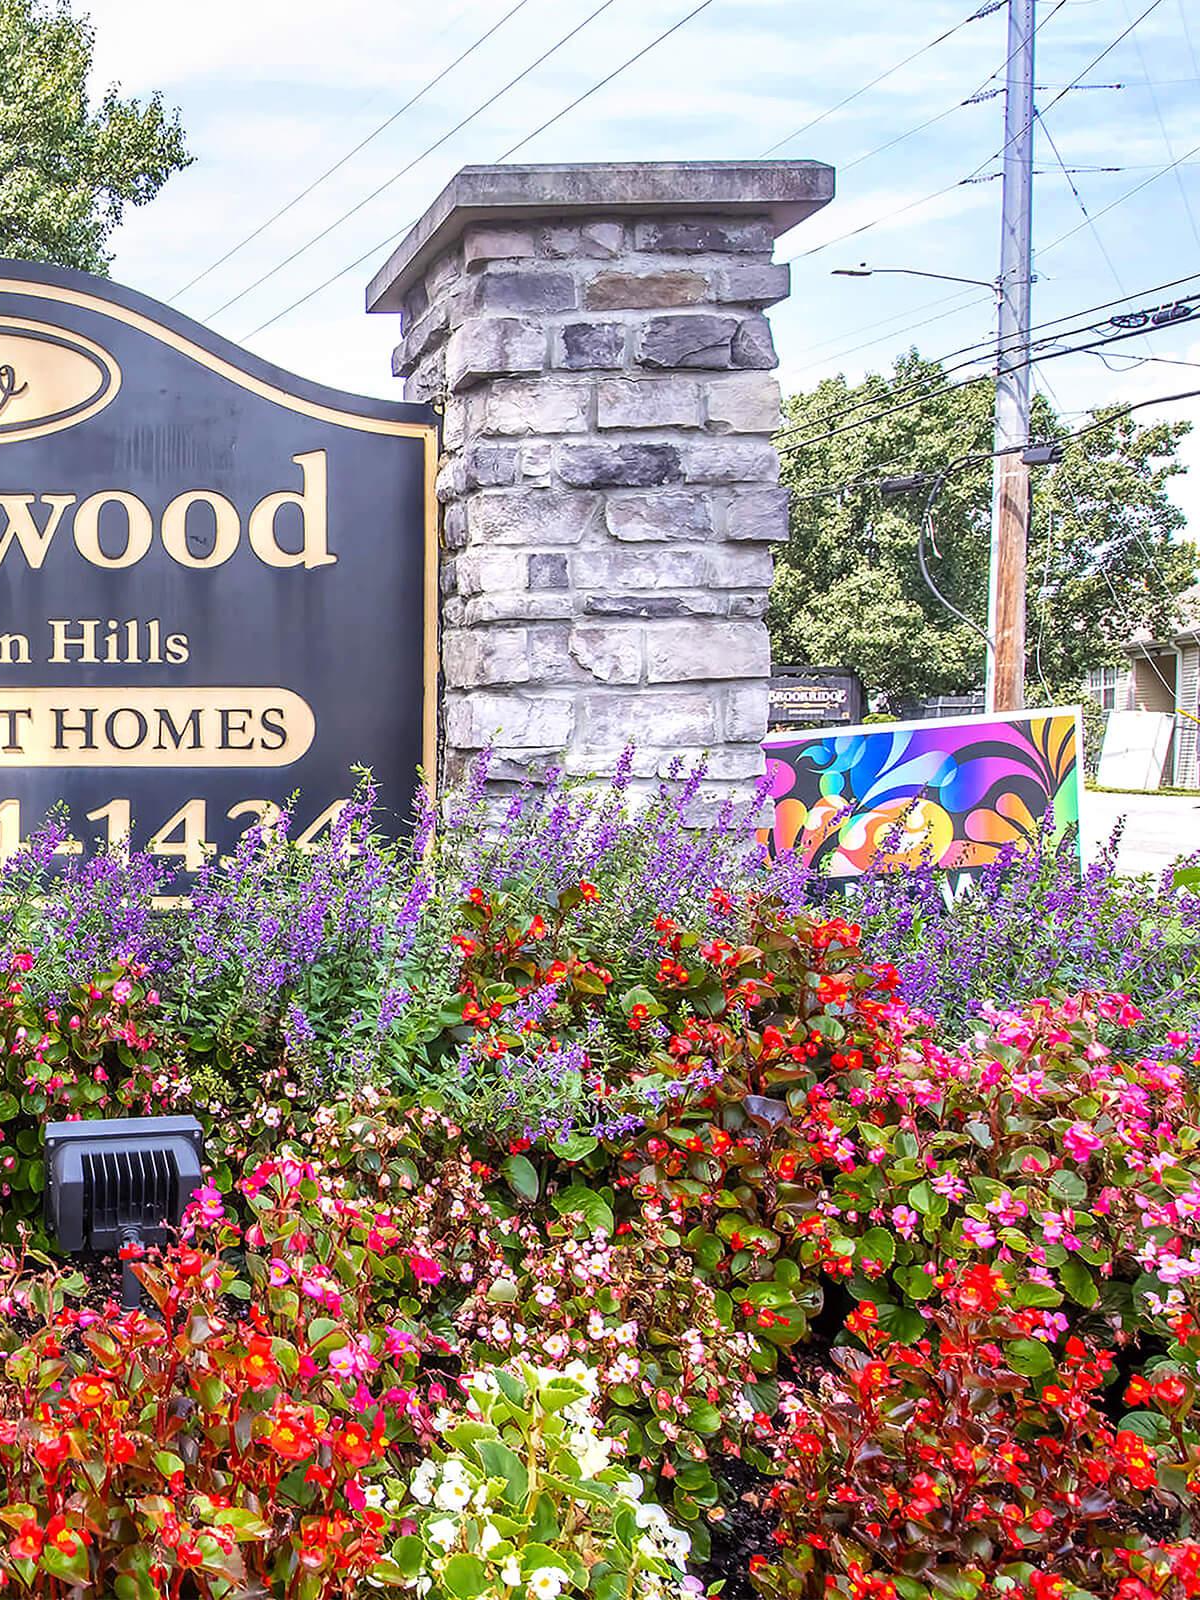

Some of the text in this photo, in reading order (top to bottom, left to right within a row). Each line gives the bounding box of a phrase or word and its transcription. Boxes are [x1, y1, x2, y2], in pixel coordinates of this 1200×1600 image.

[47, 618, 189, 664] Hills
[768, 689, 848, 703] BROOKRIDGE
[49, 707, 288, 750] HOMES
